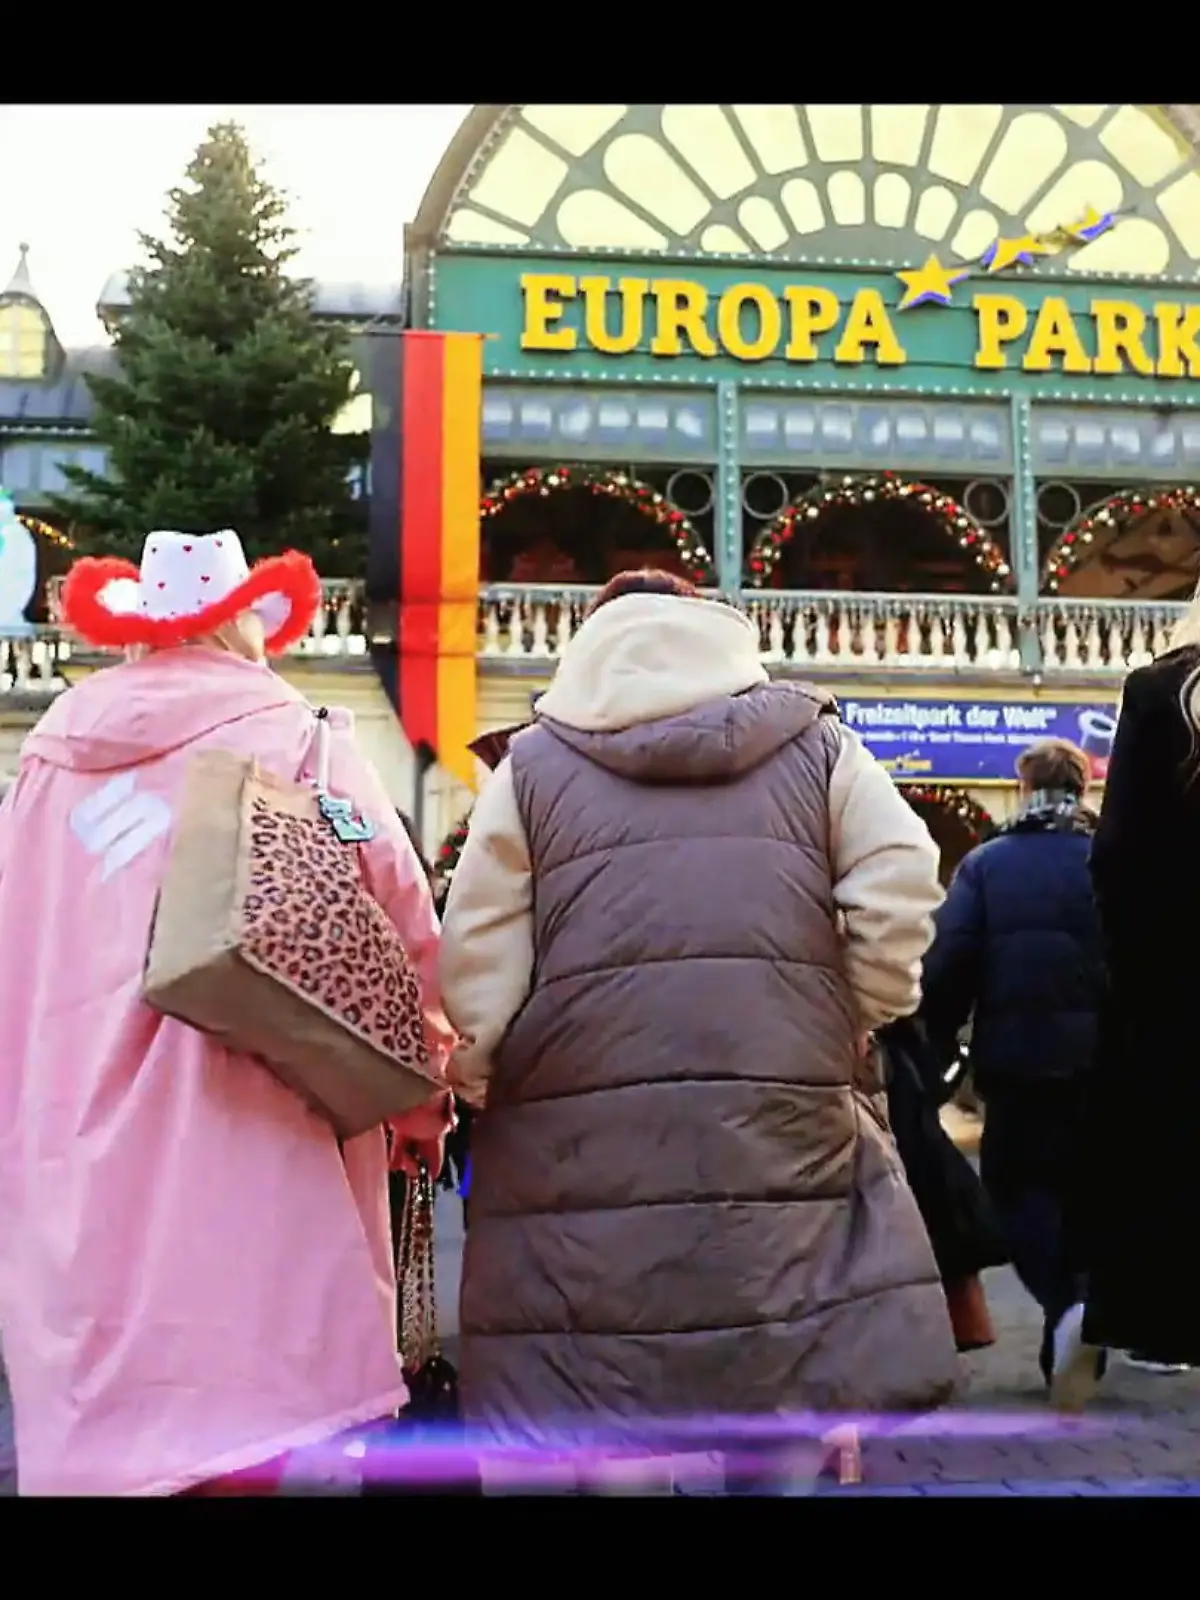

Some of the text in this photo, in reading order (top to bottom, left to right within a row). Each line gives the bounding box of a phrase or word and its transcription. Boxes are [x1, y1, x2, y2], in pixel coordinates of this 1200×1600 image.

[519, 272, 1200, 377] EUROPA PARK
[845, 702, 962, 730] Freizeitpark
[966, 705, 1000, 728] der
